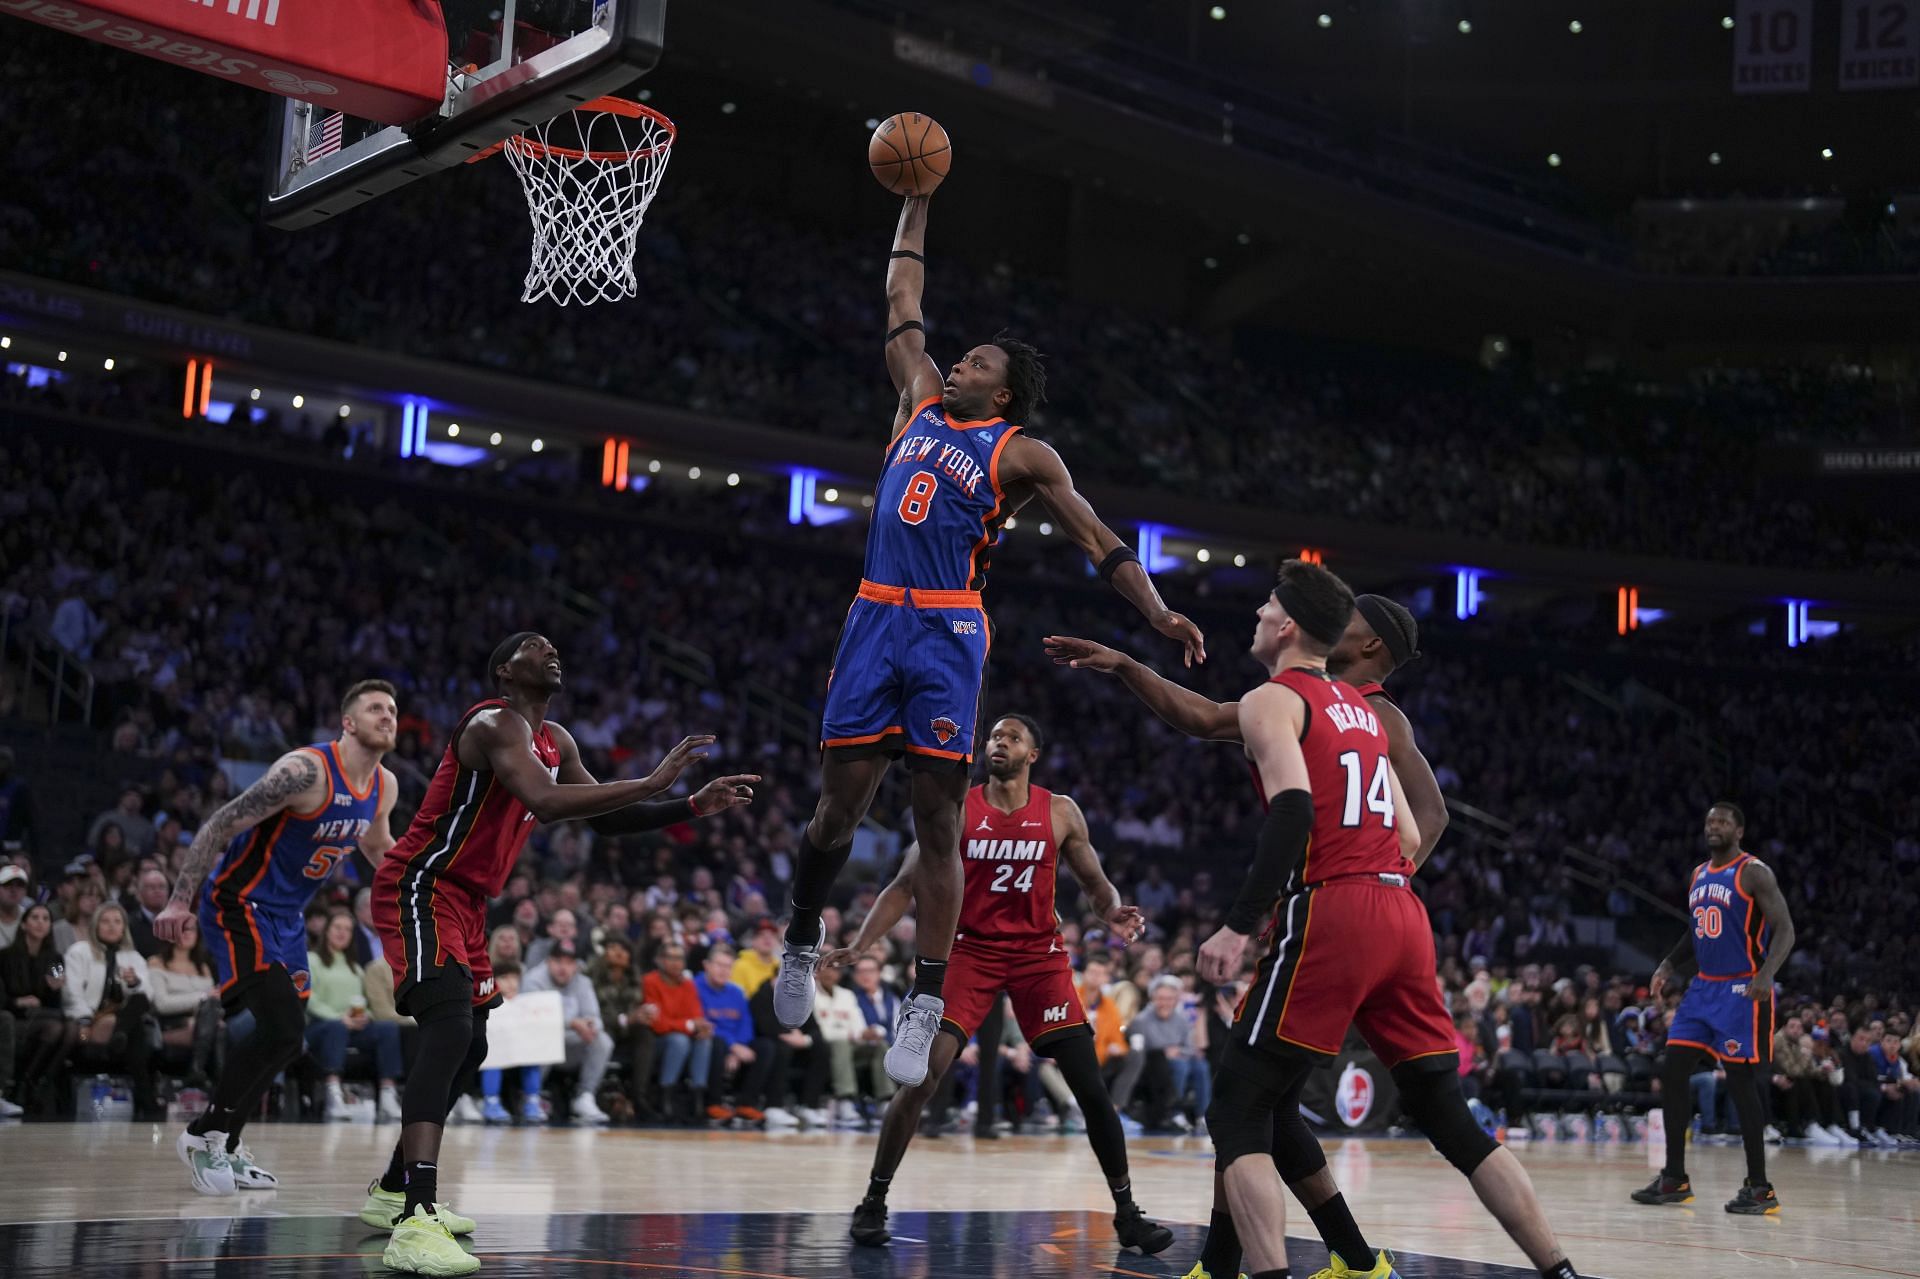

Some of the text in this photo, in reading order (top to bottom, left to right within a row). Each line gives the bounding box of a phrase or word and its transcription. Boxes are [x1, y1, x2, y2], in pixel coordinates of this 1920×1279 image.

[1749, 10, 1798, 54] 10
[1855, 4, 1907, 50] 12
[103, 26, 257, 75] State
[1738, 63, 1806, 83] KNICKS
[1844, 58, 1916, 79] KNICKS
[892, 436, 985, 499] NEW YORK
[898, 471, 938, 525] 8
[953, 621, 977, 634] NYC
[1324, 703, 1379, 737] HERRO
[1338, 750, 1394, 829] 14
[966, 839, 1047, 861] MIAMI
[990, 864, 1036, 893] 24
[1707, 883, 1732, 909] YORK
[1692, 905, 1723, 939] 30
